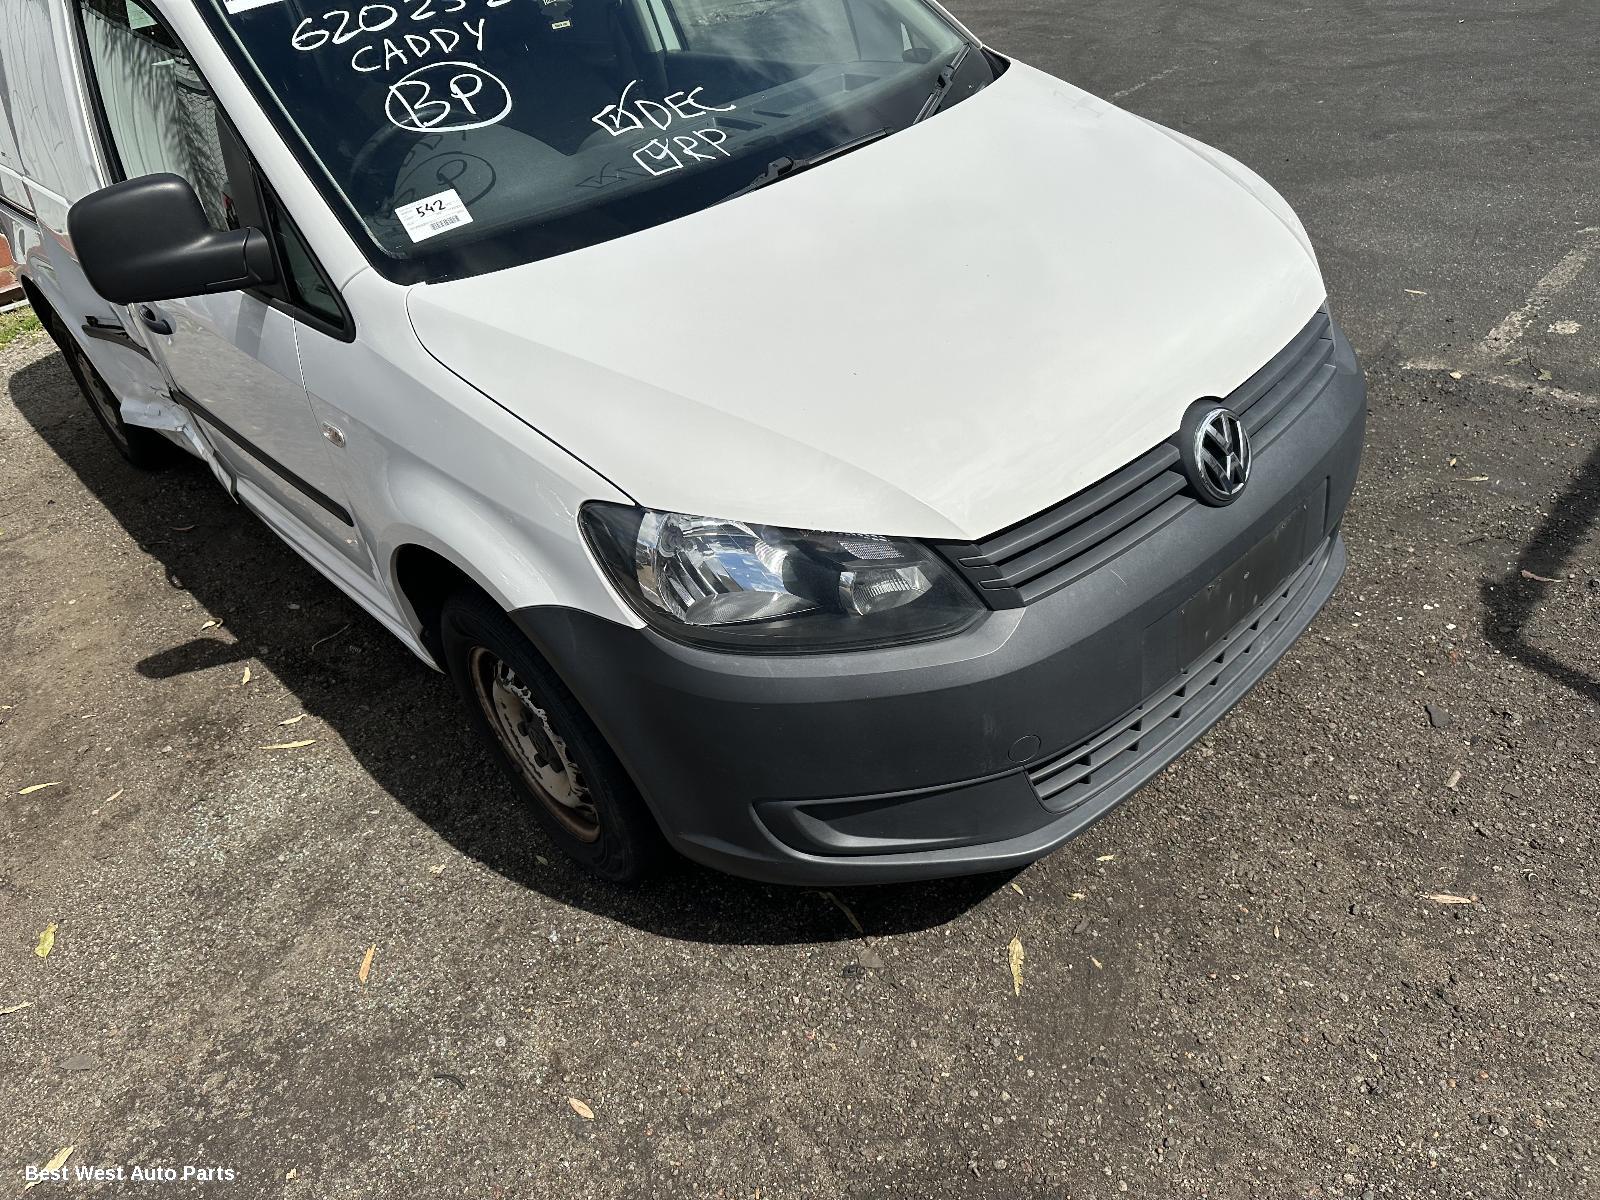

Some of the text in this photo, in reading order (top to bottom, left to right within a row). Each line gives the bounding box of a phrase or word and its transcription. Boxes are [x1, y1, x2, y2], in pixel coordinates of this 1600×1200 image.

[292, 0, 511, 50] 6202
[352, 19, 485, 71] CADDY
[389, 74, 482, 128] BP
[634, 87, 736, 131] DEC
[673, 129, 731, 162] RP
[415, 199, 446, 218] 542
[1195, 409, 1250, 498] VW
